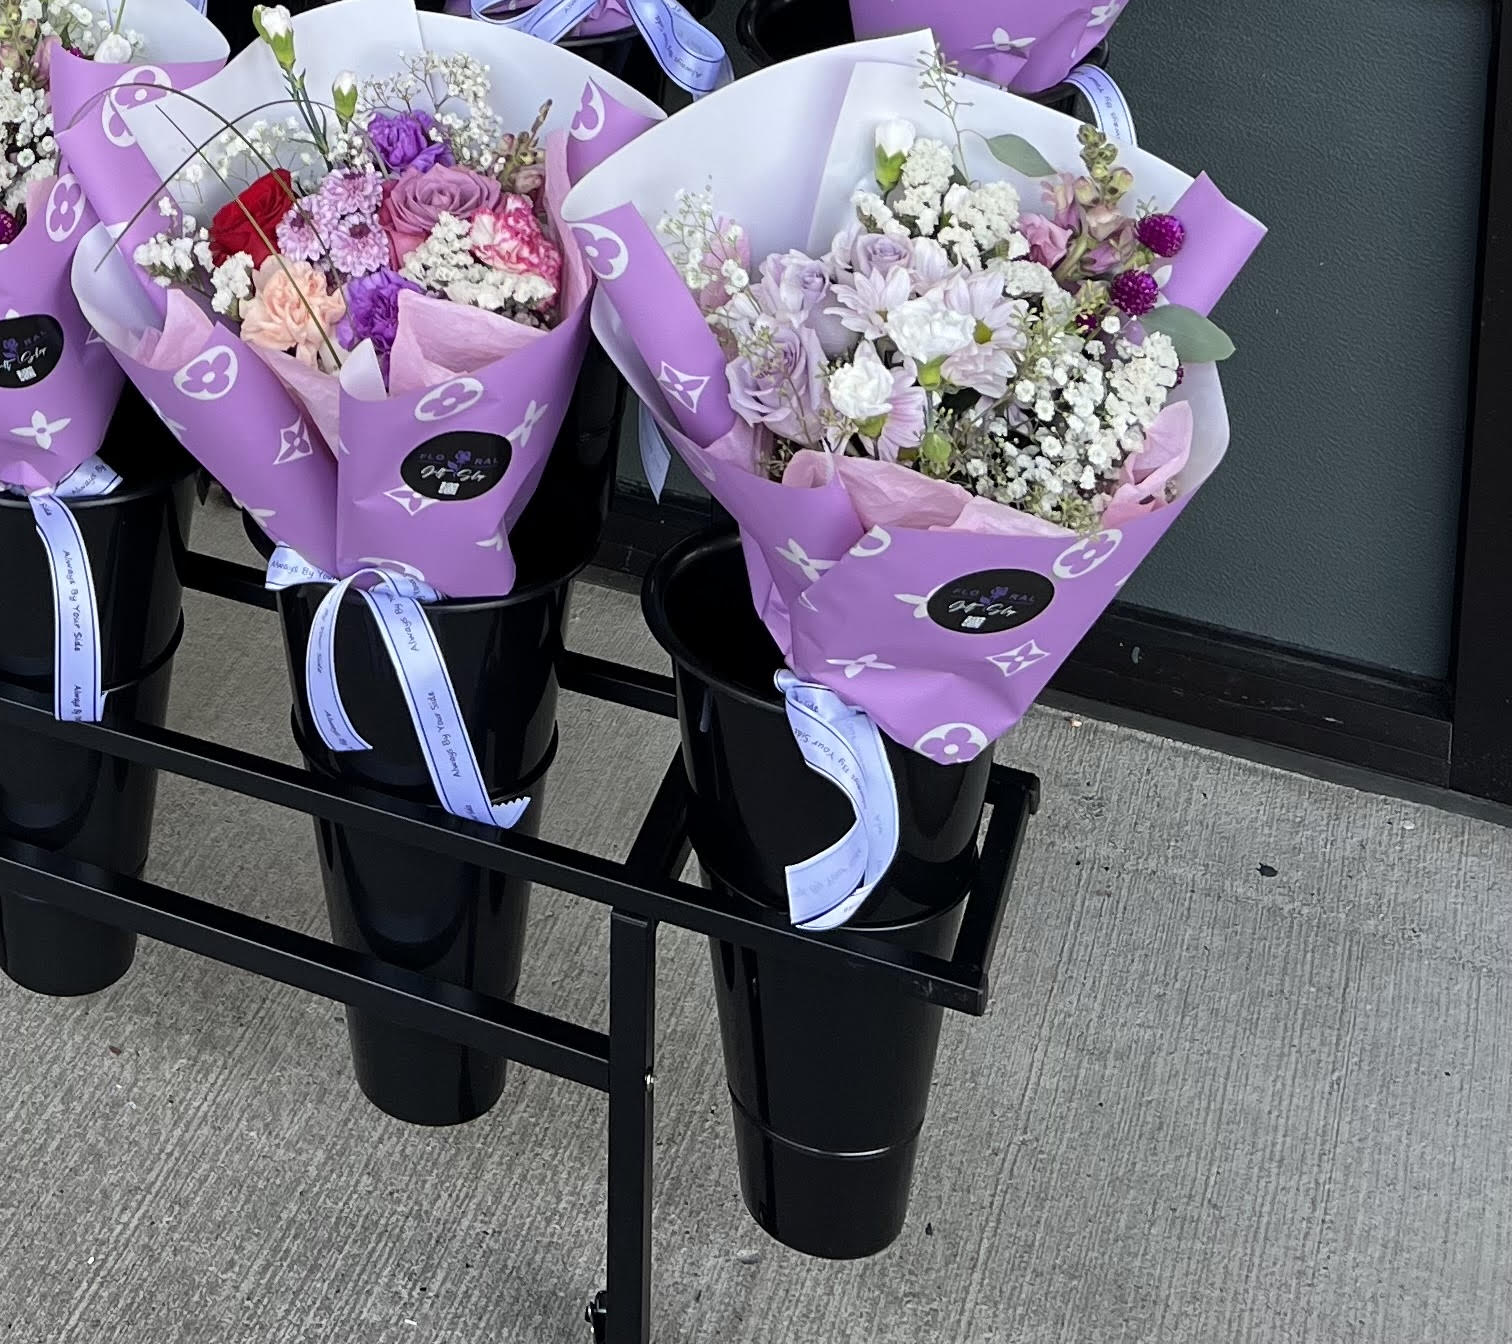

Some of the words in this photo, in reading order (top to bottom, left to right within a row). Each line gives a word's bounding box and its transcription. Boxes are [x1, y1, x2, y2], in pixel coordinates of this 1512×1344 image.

[63, 550, 75, 585] Always
[271, 561, 298, 574] Always
[302, 567, 315, 578] By
[69, 589, 79, 602] By
[73, 606, 81, 629] Your
[394, 603, 403, 615] By
[74, 632, 83, 652] Side
[400, 617, 421, 652] Always
[434, 713, 444, 732] Your
[441, 733, 451, 746] By
[812, 740, 834, 760] Your
[447, 748, 462, 778] Always
